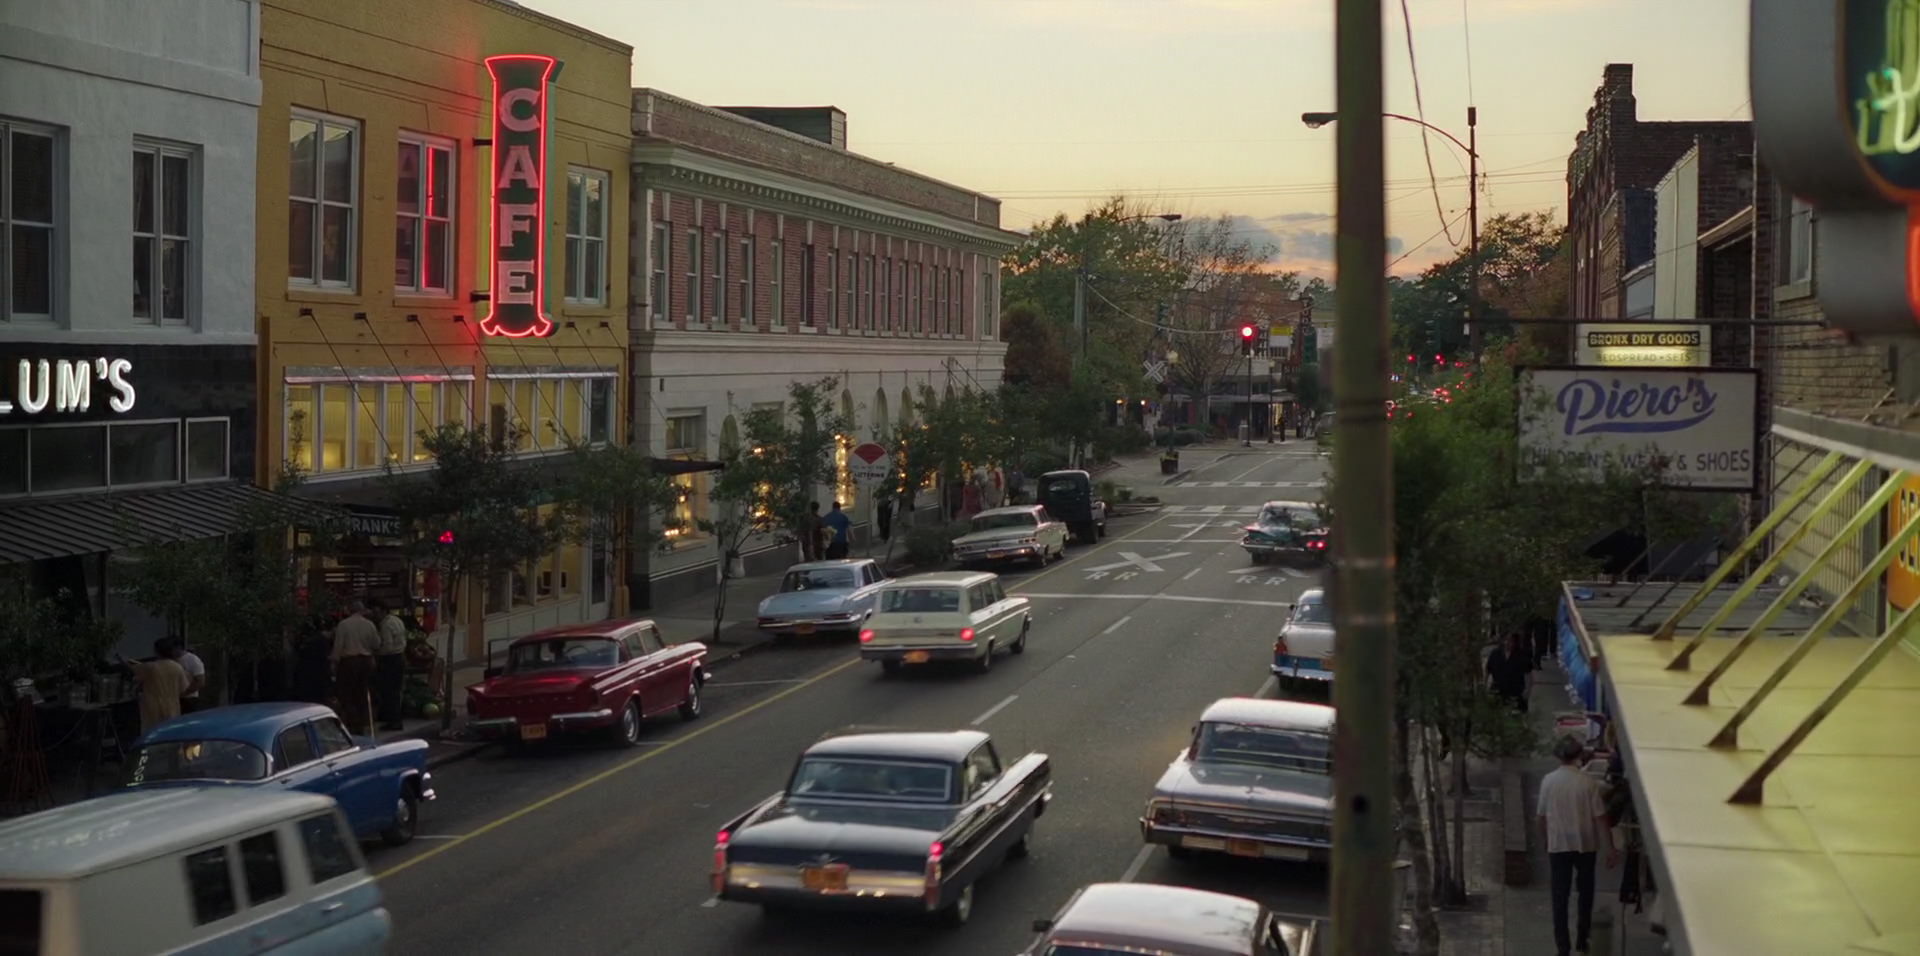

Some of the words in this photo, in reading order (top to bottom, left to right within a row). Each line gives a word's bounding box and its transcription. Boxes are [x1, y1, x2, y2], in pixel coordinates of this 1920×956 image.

[497, 88, 542, 307] CAFE
[1590, 333, 1629, 346] BRONX
[1632, 333, 1655, 345] DRY
[1658, 332, 1699, 345] GOODS
[1556, 377, 1718, 436] Piero's
[1677, 453, 1688, 470] &
[1696, 449, 1751, 473] SHOES
